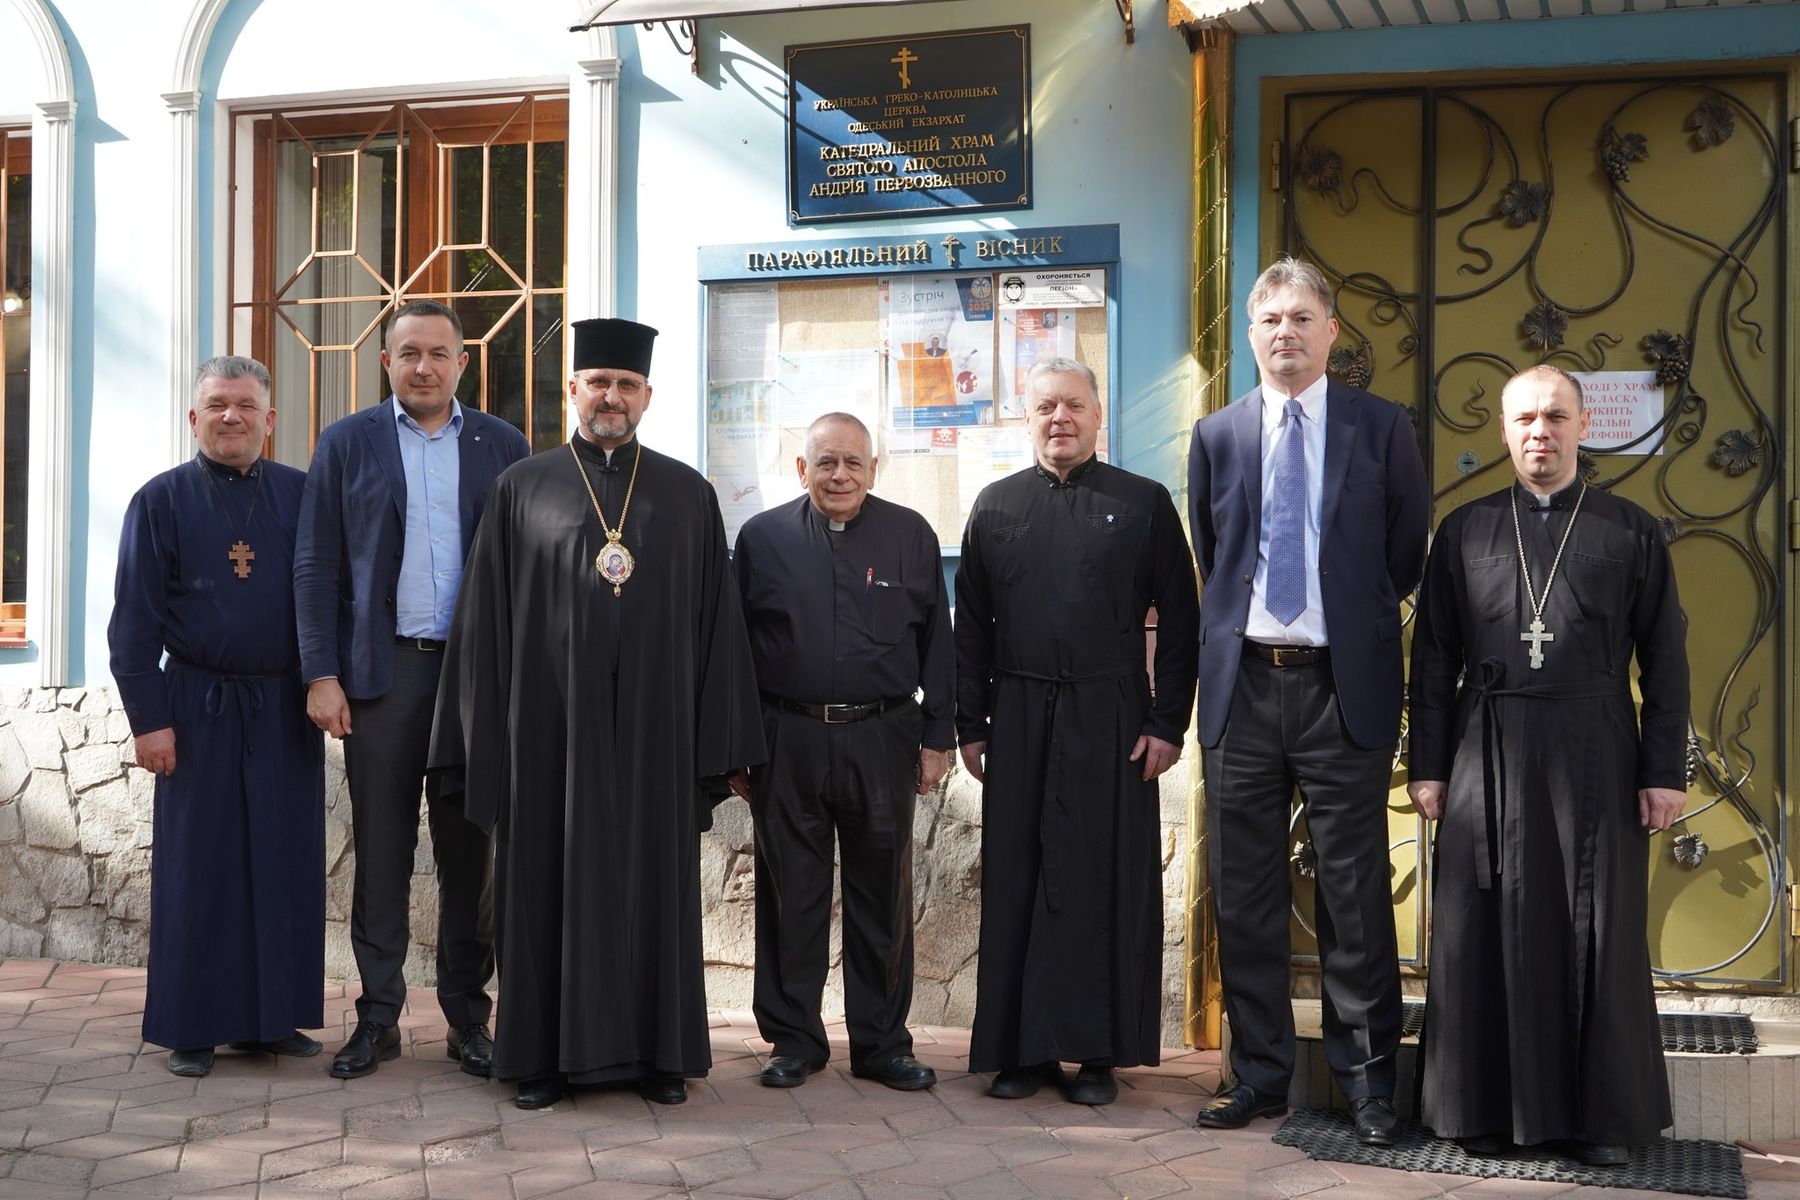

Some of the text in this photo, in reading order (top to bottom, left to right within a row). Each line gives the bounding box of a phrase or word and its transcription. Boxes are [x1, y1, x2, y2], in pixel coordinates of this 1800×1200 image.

[813, 86, 998, 110] УКРАЇНСЬКА ГРЕКО-КАТОЛИЦЬКА
[884, 105, 927, 117] ЦЕРКВА
[848, 114, 966, 132] ОДЕСЬКИЙ ЕКЗАРХАТ
[820, 134, 995, 160] КАТЕДРАЛЬНИЙ ХРАМ
[826, 153, 987, 177] СВЯТОГО АПОСТОЛА
[809, 170, 1006, 197] АНДРІЯ ПЕРВОЗВАННОГО
[746, 236, 1064, 269] ПАРАФІЯЛЬНИЙ ВІСНИК
[1036, 272, 1091, 280] ОХОРОНЯЄТЬСЯ
[900, 290, 945, 305] Зустріч
[1582, 383, 1657, 392] ХОДІ У ХРАМ
[1598, 395, 1639, 403] ЛАСКА
[1589, 419, 1632, 427] БІЛЬНІ
